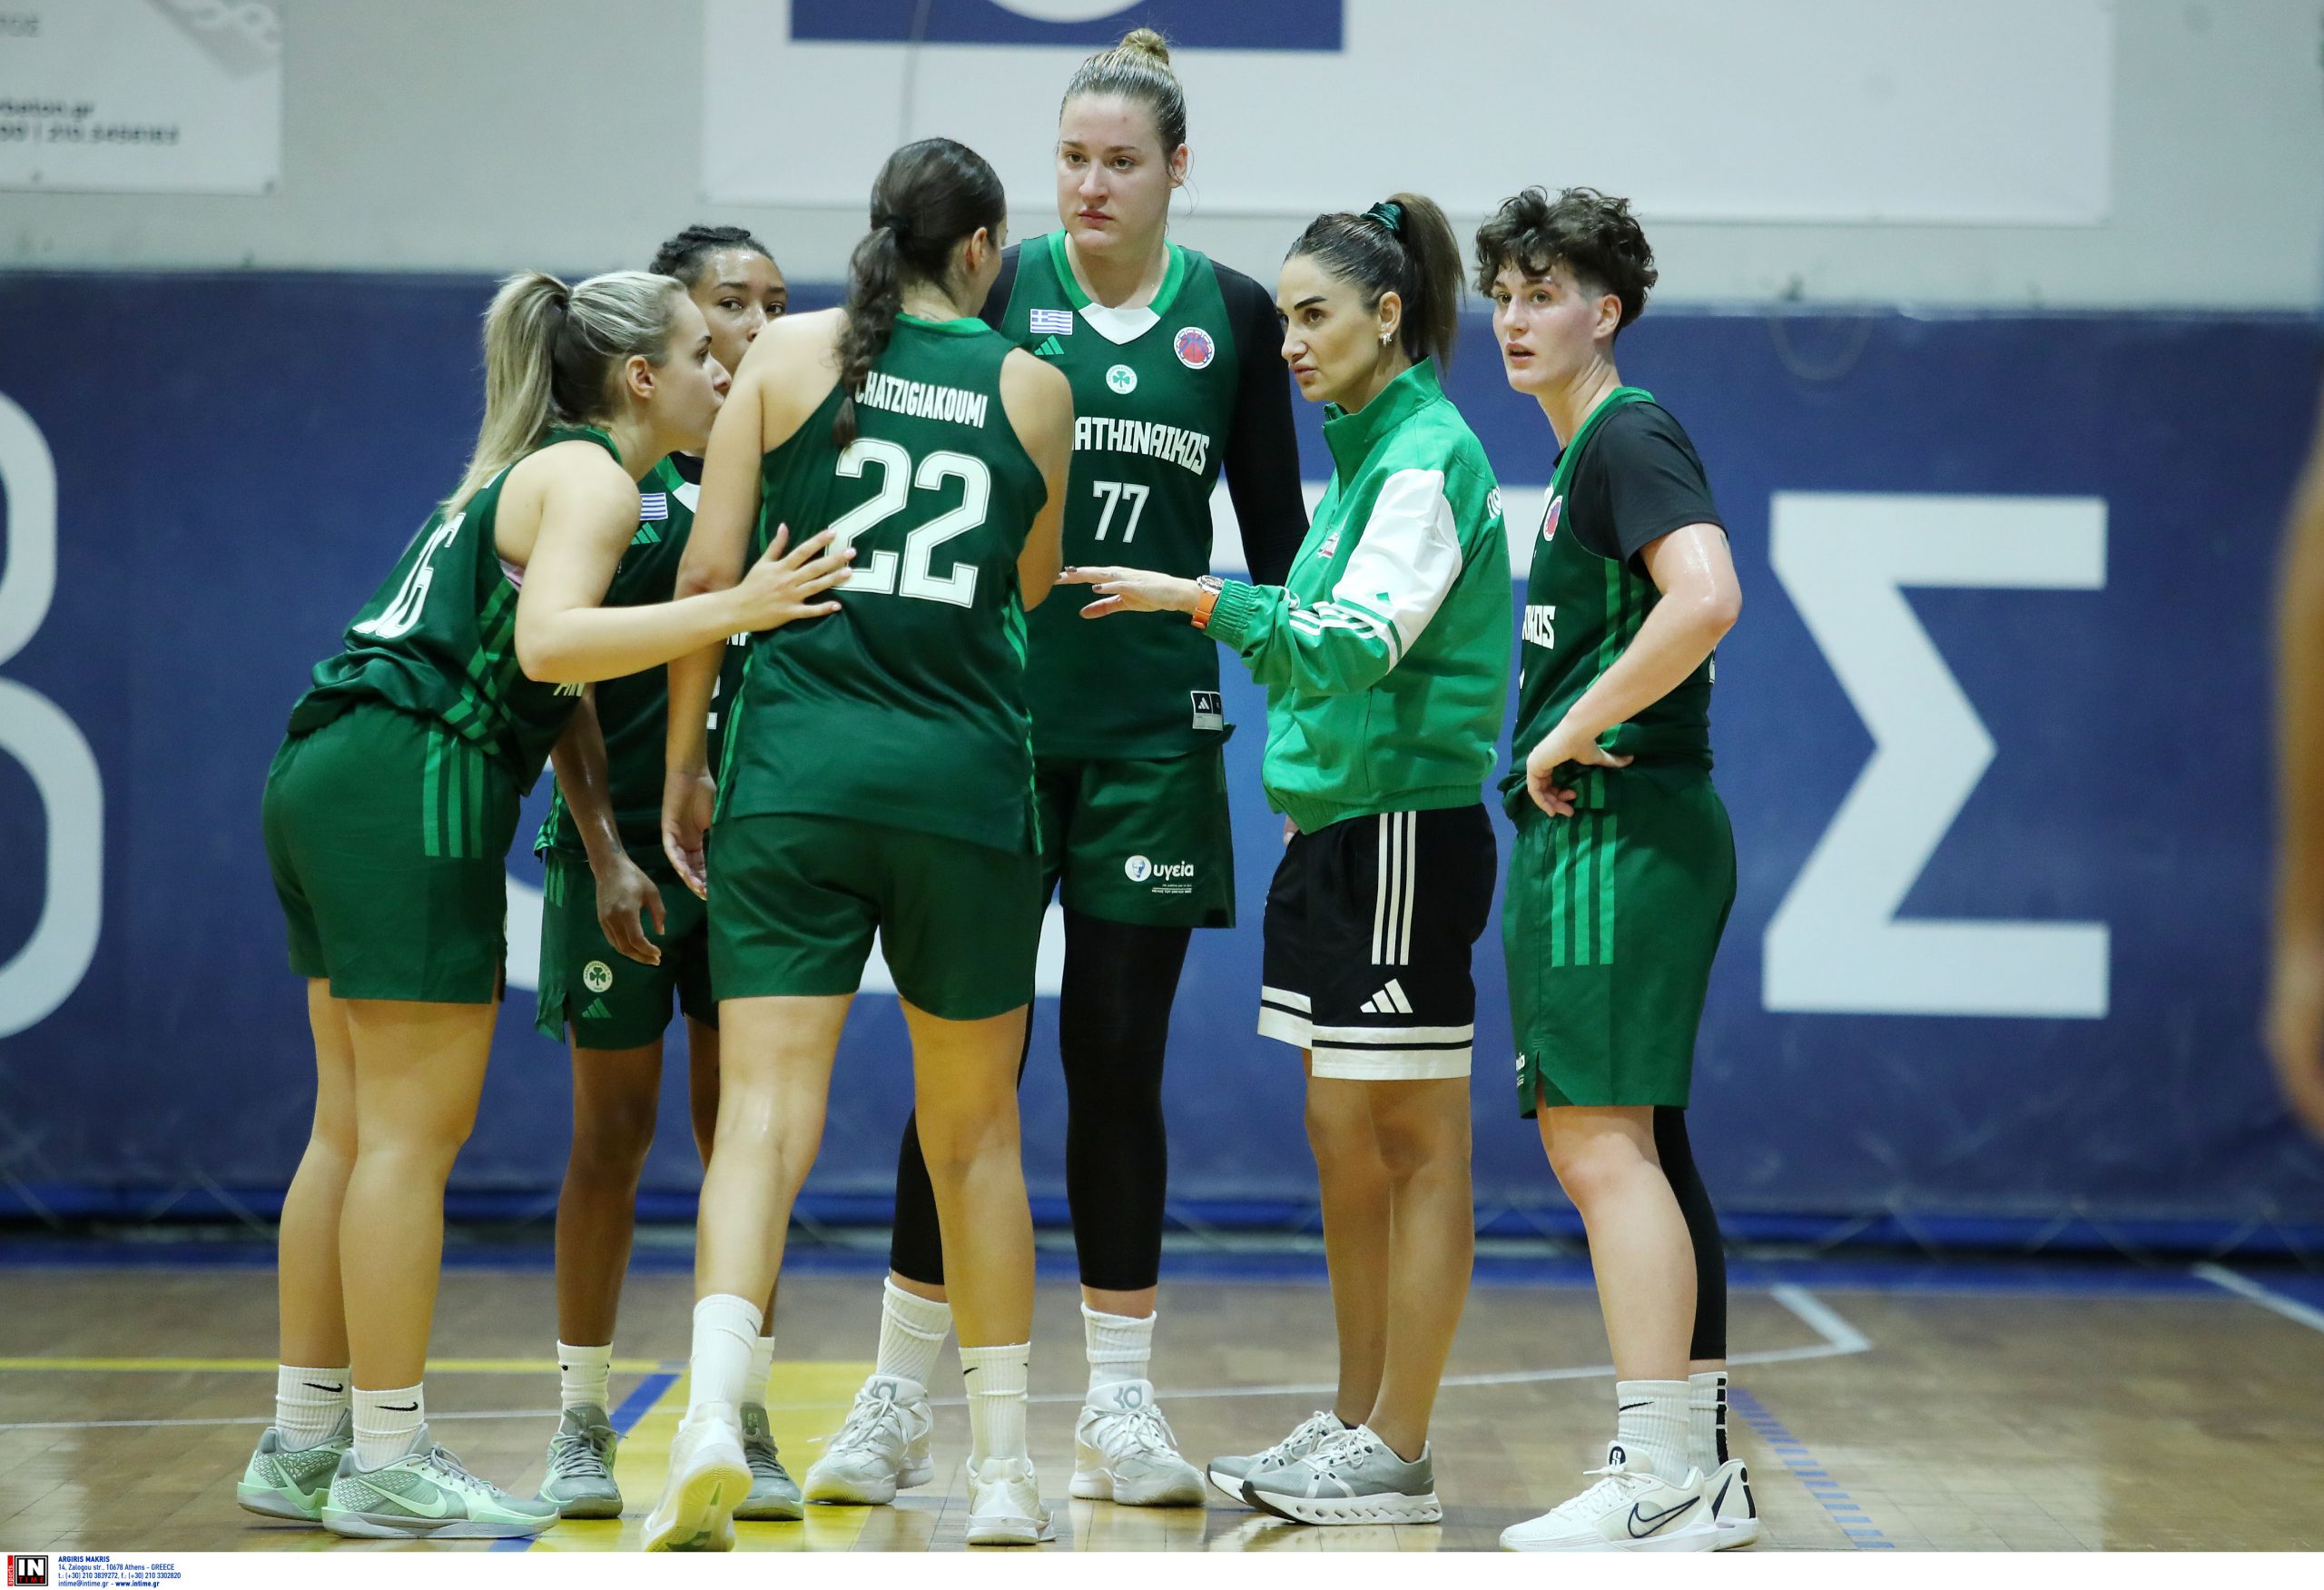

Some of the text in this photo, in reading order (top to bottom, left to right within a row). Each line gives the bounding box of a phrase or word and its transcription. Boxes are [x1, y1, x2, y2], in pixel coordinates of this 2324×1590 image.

[1072, 416, 1210, 476] ATHINAIKOS
[824, 438, 991, 609] 22
[1092, 480, 1150, 544] 77
